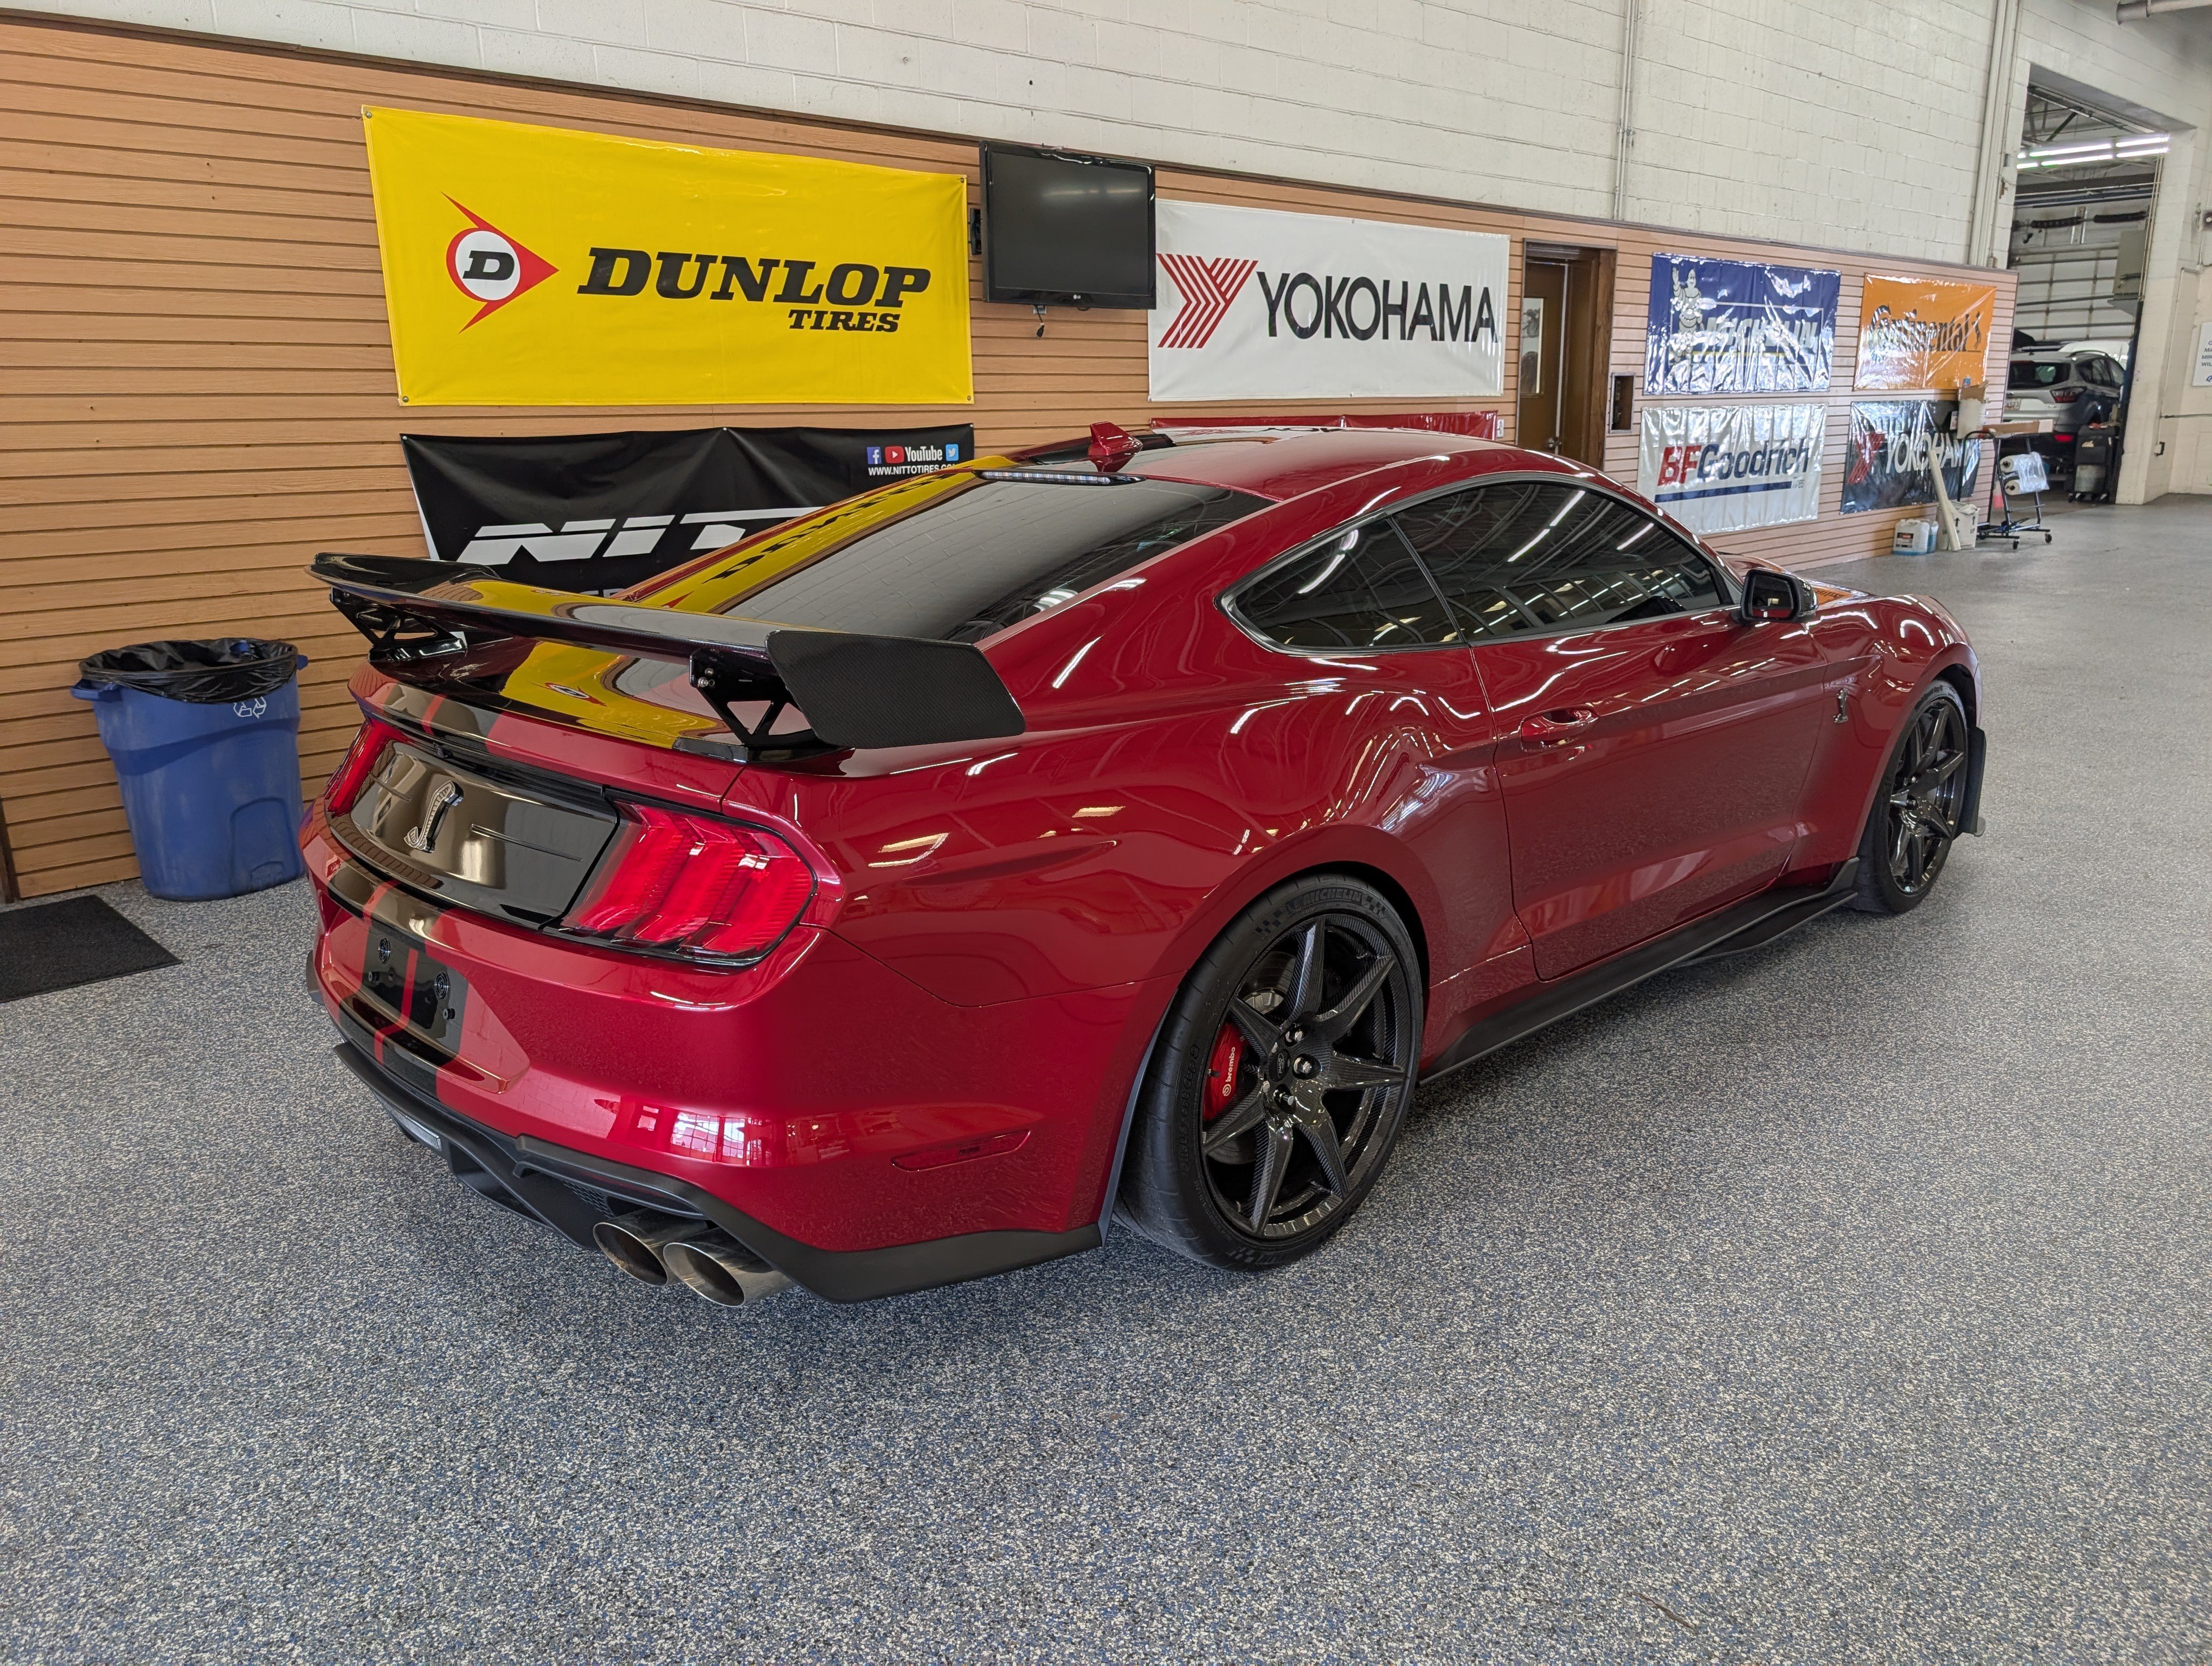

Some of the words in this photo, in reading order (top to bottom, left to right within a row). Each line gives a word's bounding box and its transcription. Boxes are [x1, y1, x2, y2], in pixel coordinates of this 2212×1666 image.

[462, 250, 515, 280] D
[577, 247, 931, 309] DUNLOP
[788, 309, 901, 333] TIRES
[1257, 272, 1498, 343] YOKOHAMA
[868, 464, 955, 476] WWW.NITTOTIRESC
[904, 445, 943, 462] YouTube
[1657, 436, 1809, 486] BFGoodrich
[456, 507, 826, 565] NIT
[1303, 887, 1362, 906] MICHELIN
[1183, 1060, 1195, 1089] Cup
[1189, 1043, 1200, 1059] 2
[1225, 1047, 1236, 1082] brembo
